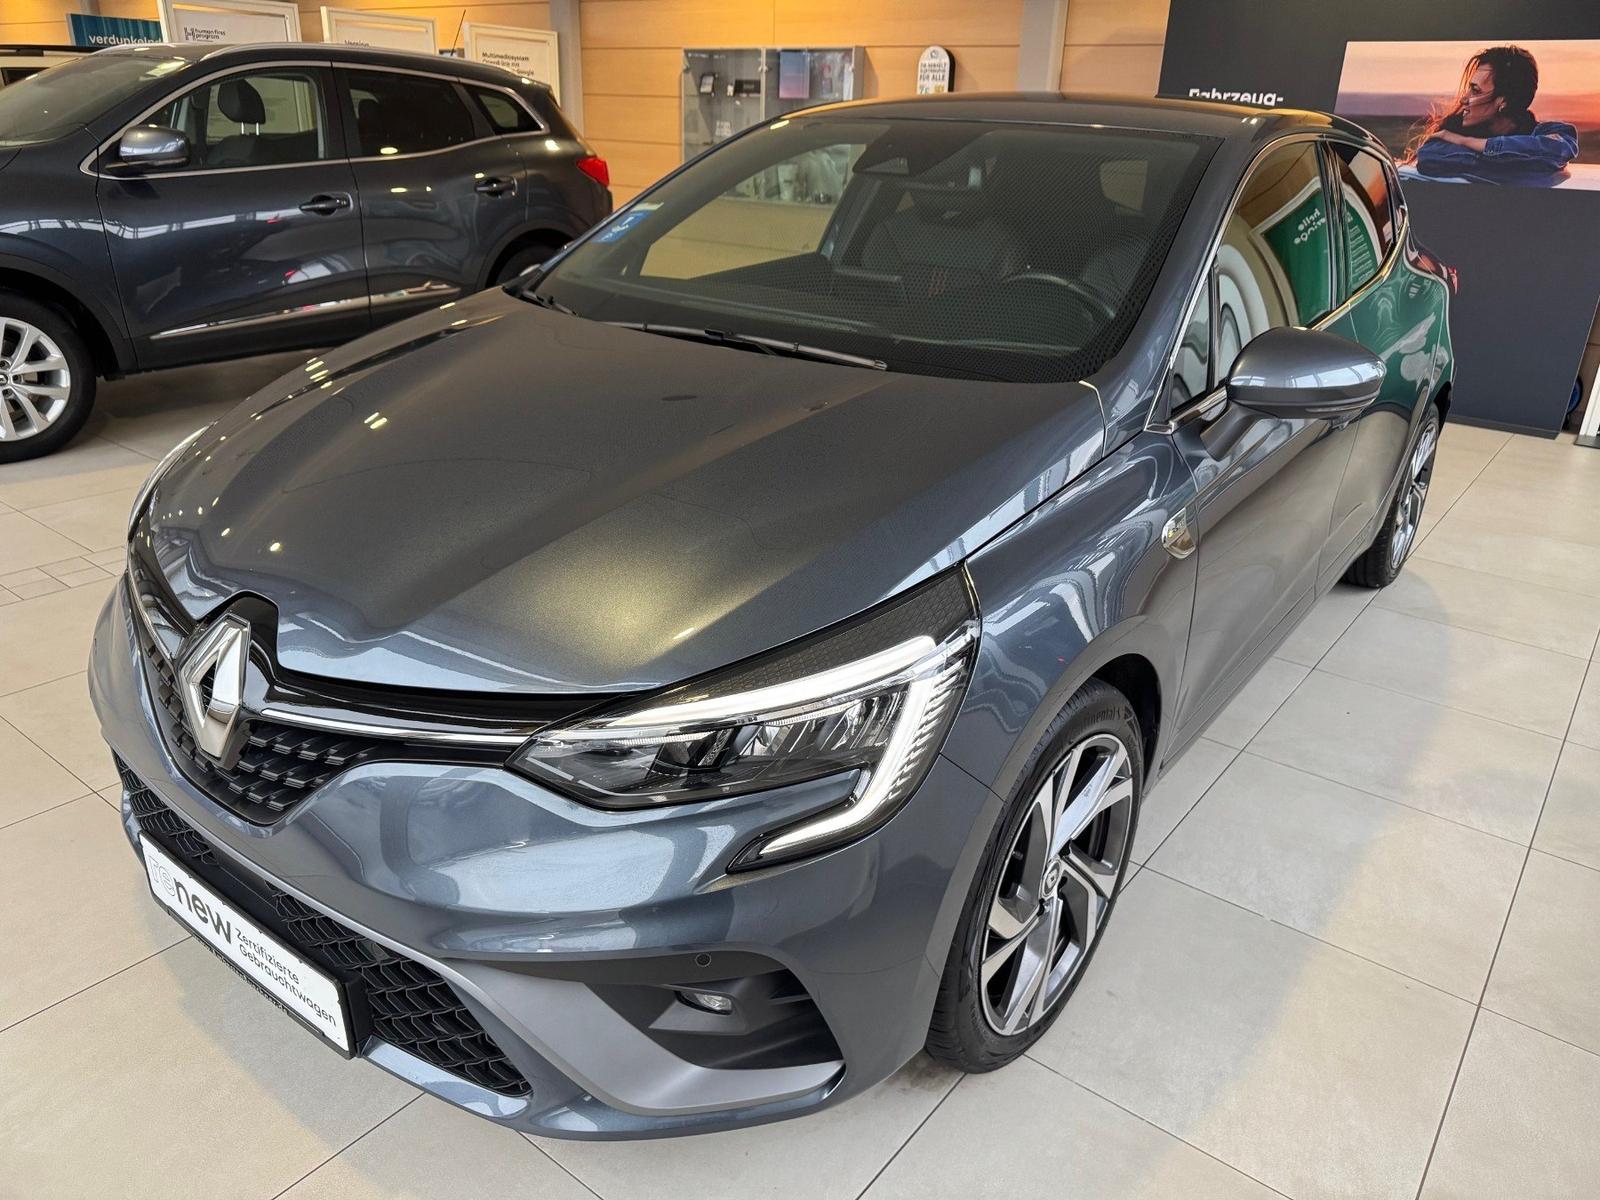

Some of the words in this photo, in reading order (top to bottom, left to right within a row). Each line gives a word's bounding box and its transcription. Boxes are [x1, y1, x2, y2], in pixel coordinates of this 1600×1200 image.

[148, 855, 232, 944] renew
[235, 928, 300, 984] Zertifizierte
[239, 944, 337, 1027] Gebrauchtwagen
